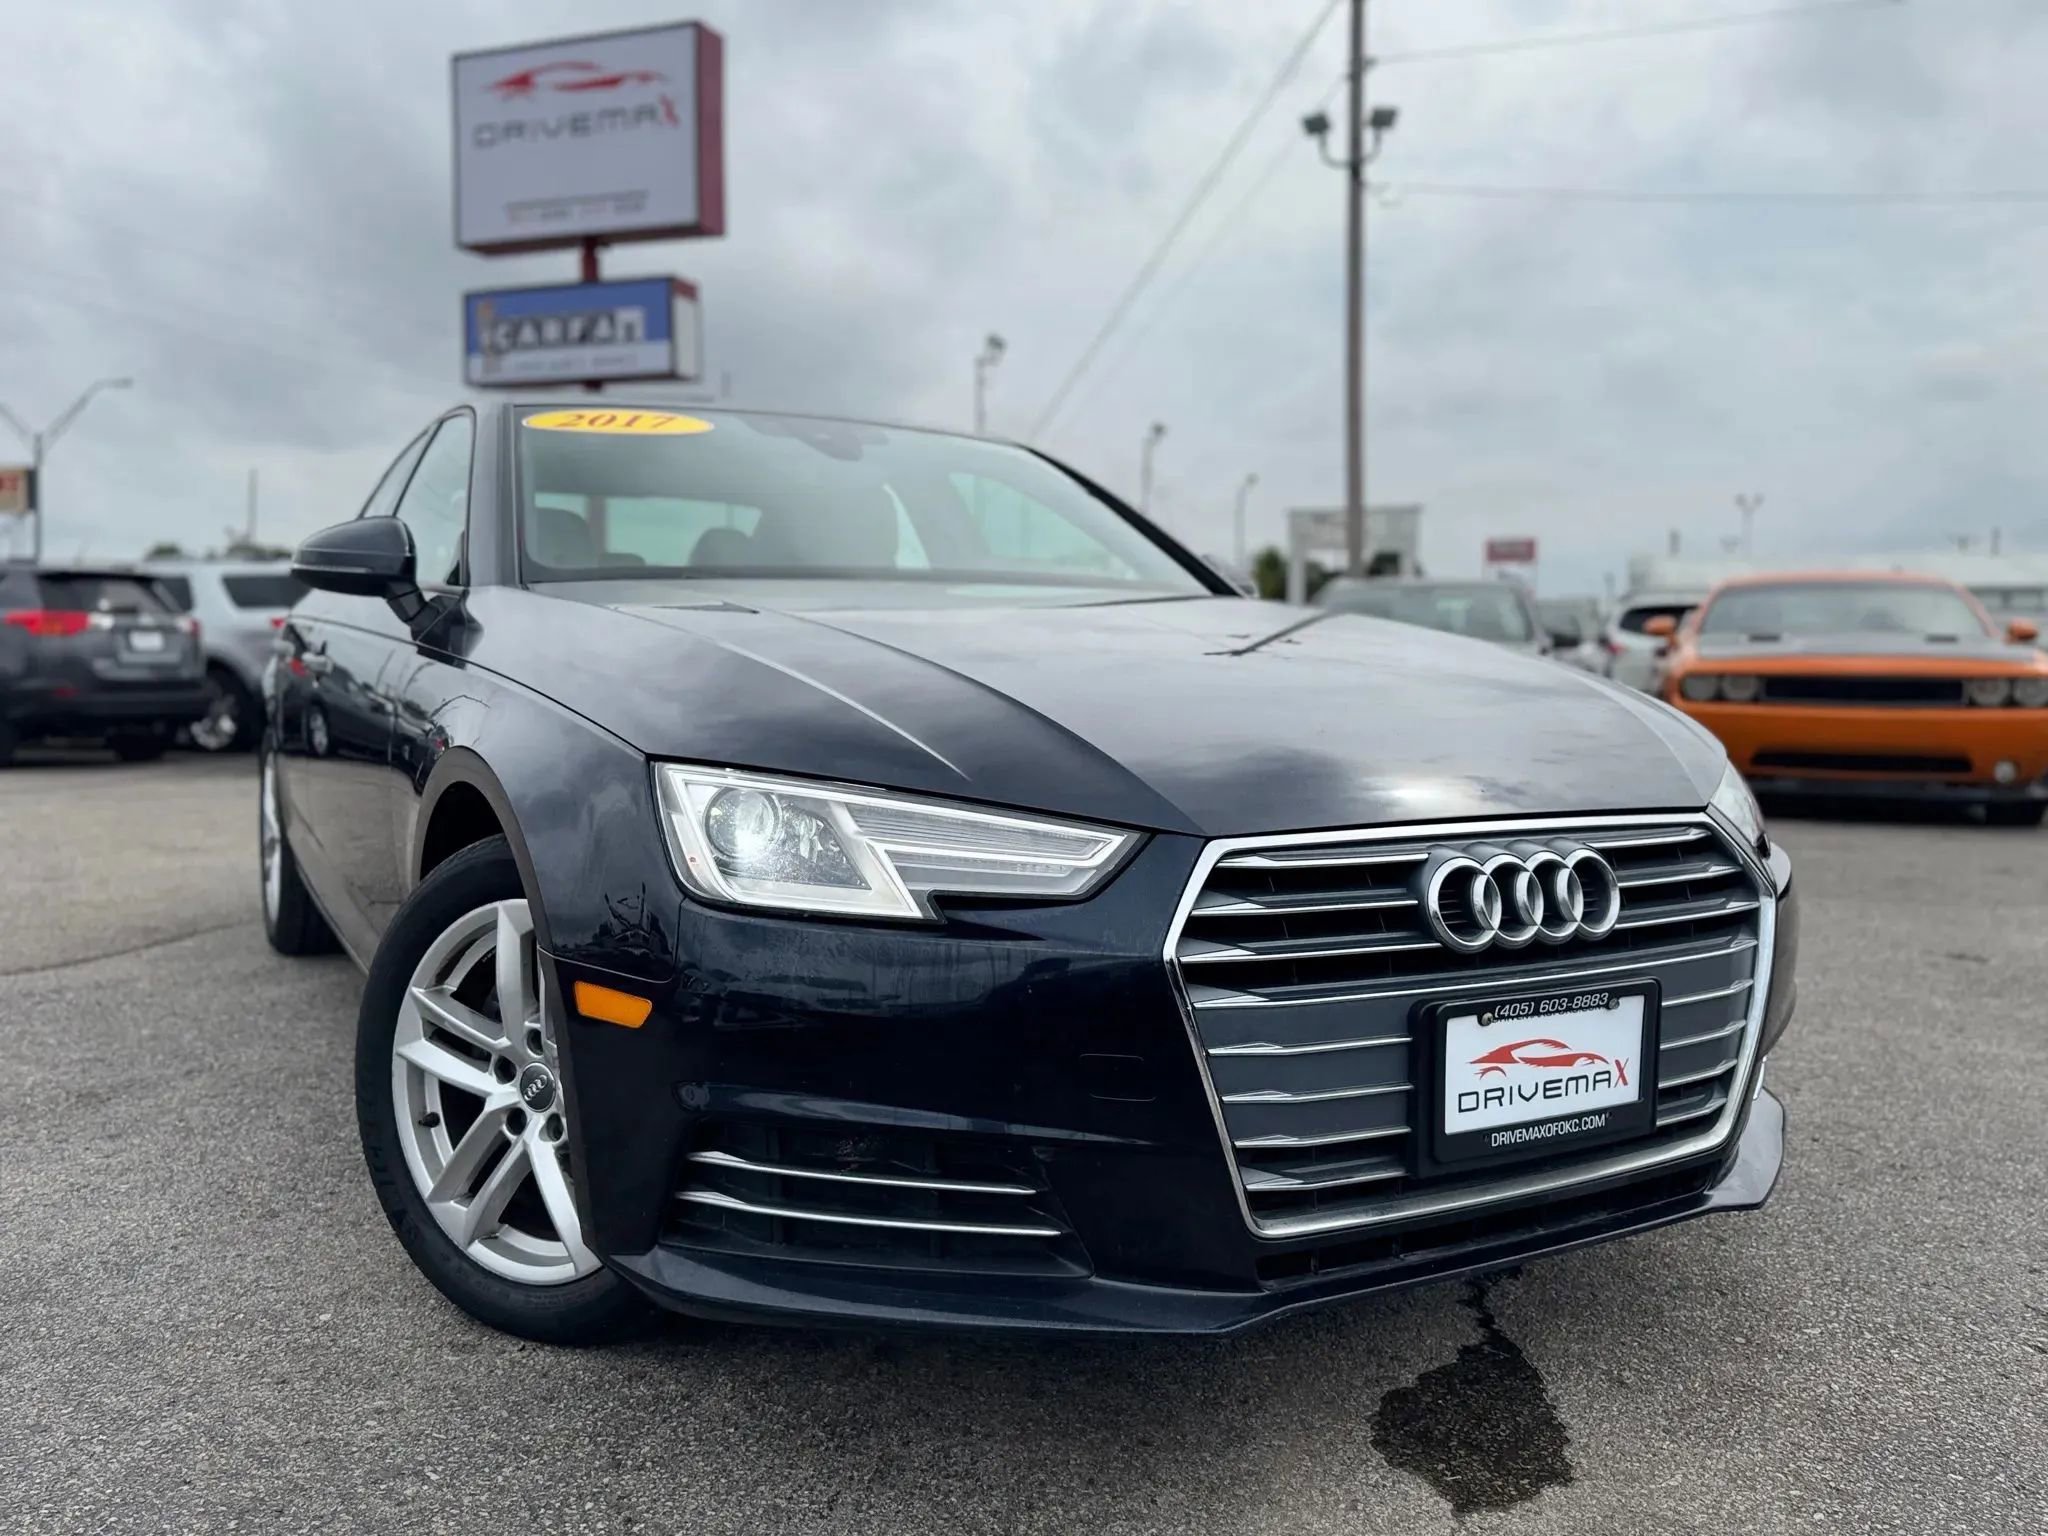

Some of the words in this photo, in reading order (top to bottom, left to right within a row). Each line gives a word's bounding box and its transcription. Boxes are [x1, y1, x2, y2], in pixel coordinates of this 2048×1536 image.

[473, 95, 679, 148] DRIVEMAX
[556, 412, 677, 430] 2017
[1494, 1002, 1534, 1019] (405)
[1539, 992, 1608, 1013] 603-8883
[1458, 1057, 1629, 1113] DRIVEMAX
[1491, 1114, 1606, 1147] DRIVEMAXOFOKC.COM
